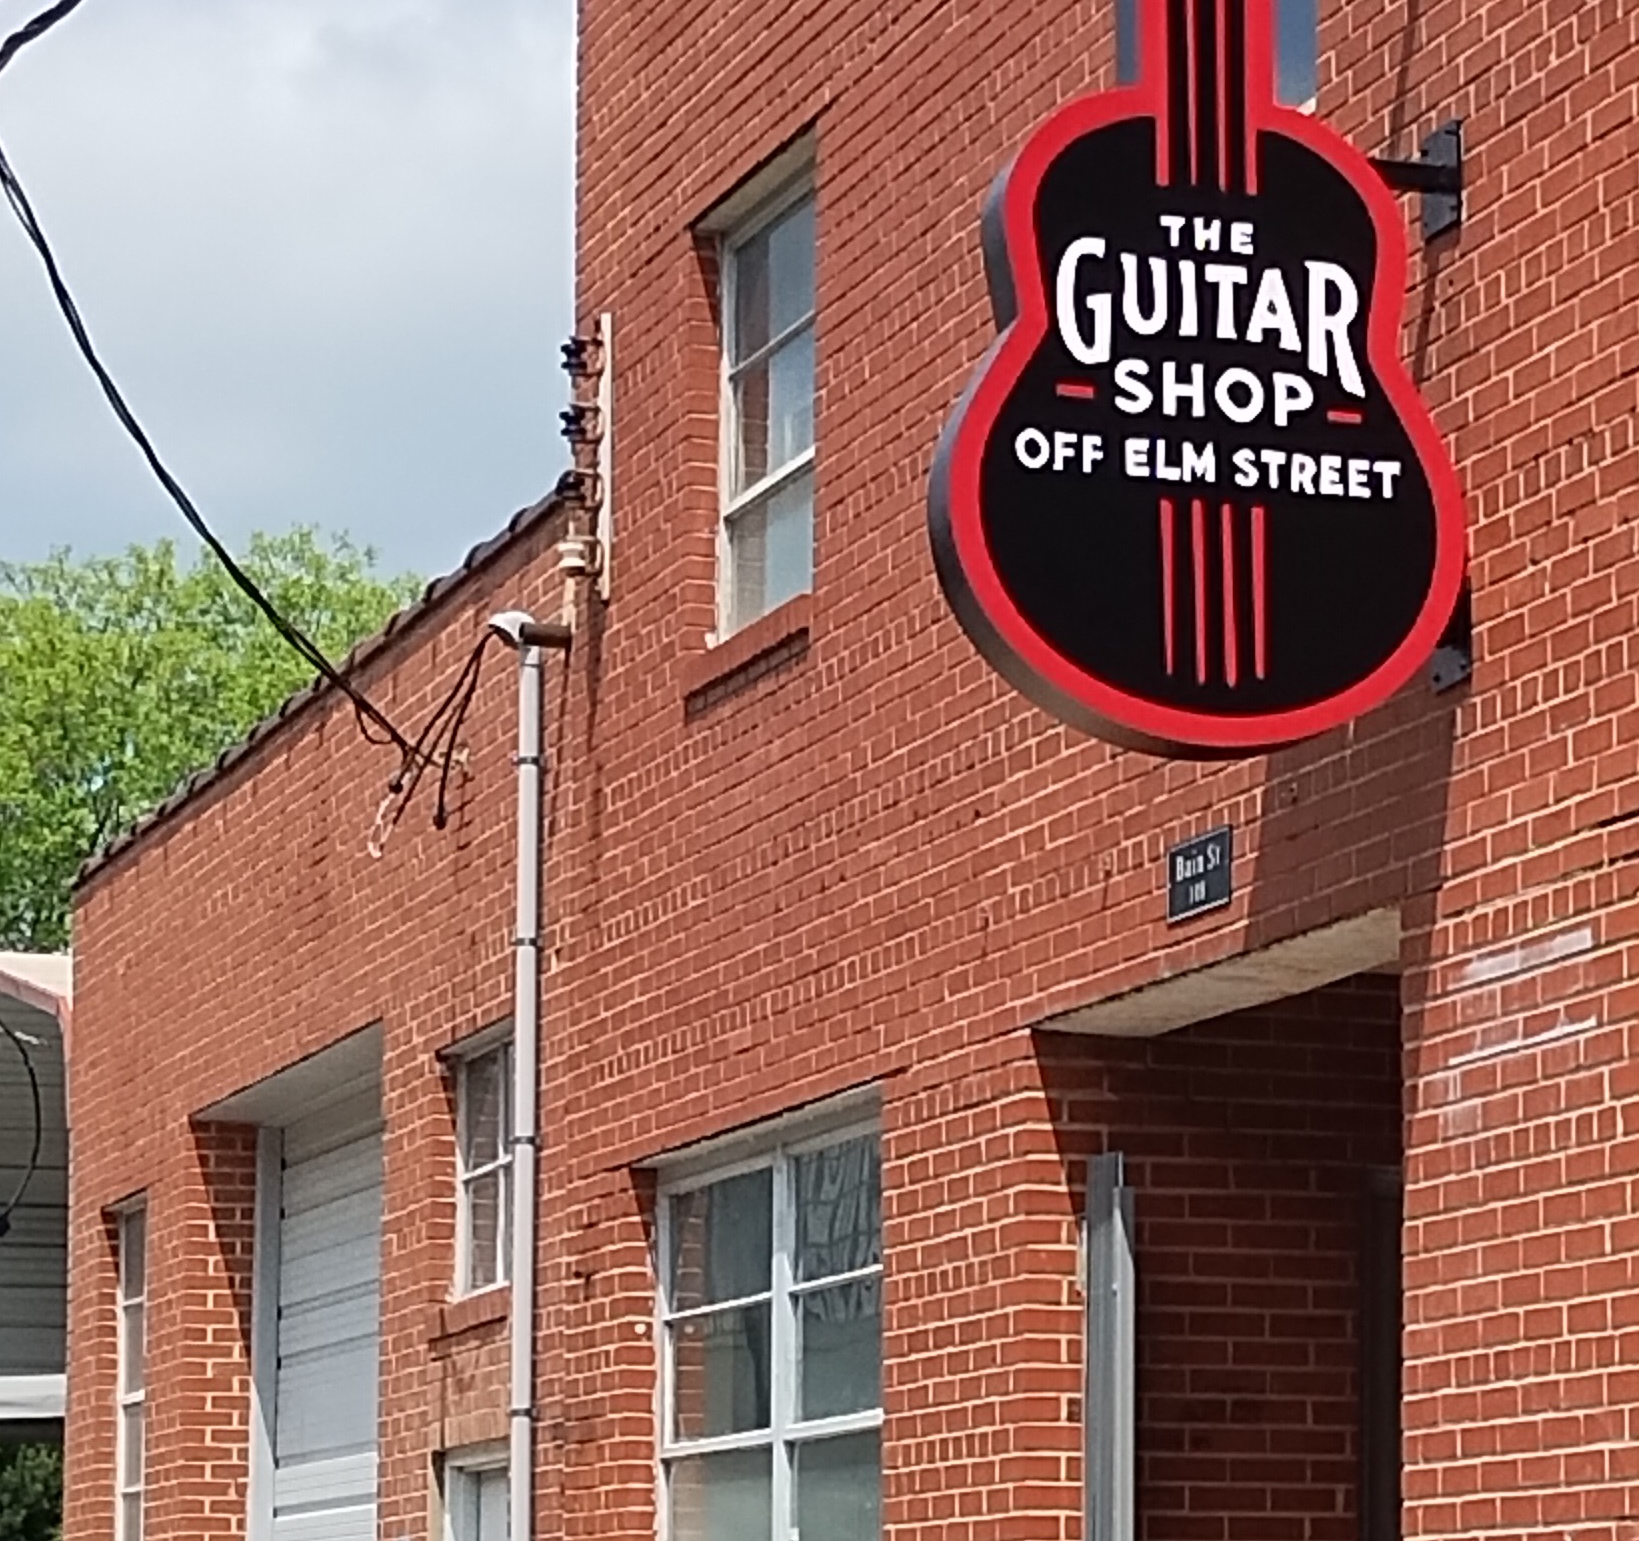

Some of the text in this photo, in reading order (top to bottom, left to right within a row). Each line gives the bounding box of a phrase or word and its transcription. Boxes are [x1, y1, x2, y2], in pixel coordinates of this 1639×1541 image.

[1159, 215, 1254, 255] THE
[1056, 236, 1366, 398] GUITAR
[1114, 358, 1314, 427] SHOP
[1014, 427, 1402, 499] OFF ELM STREET
